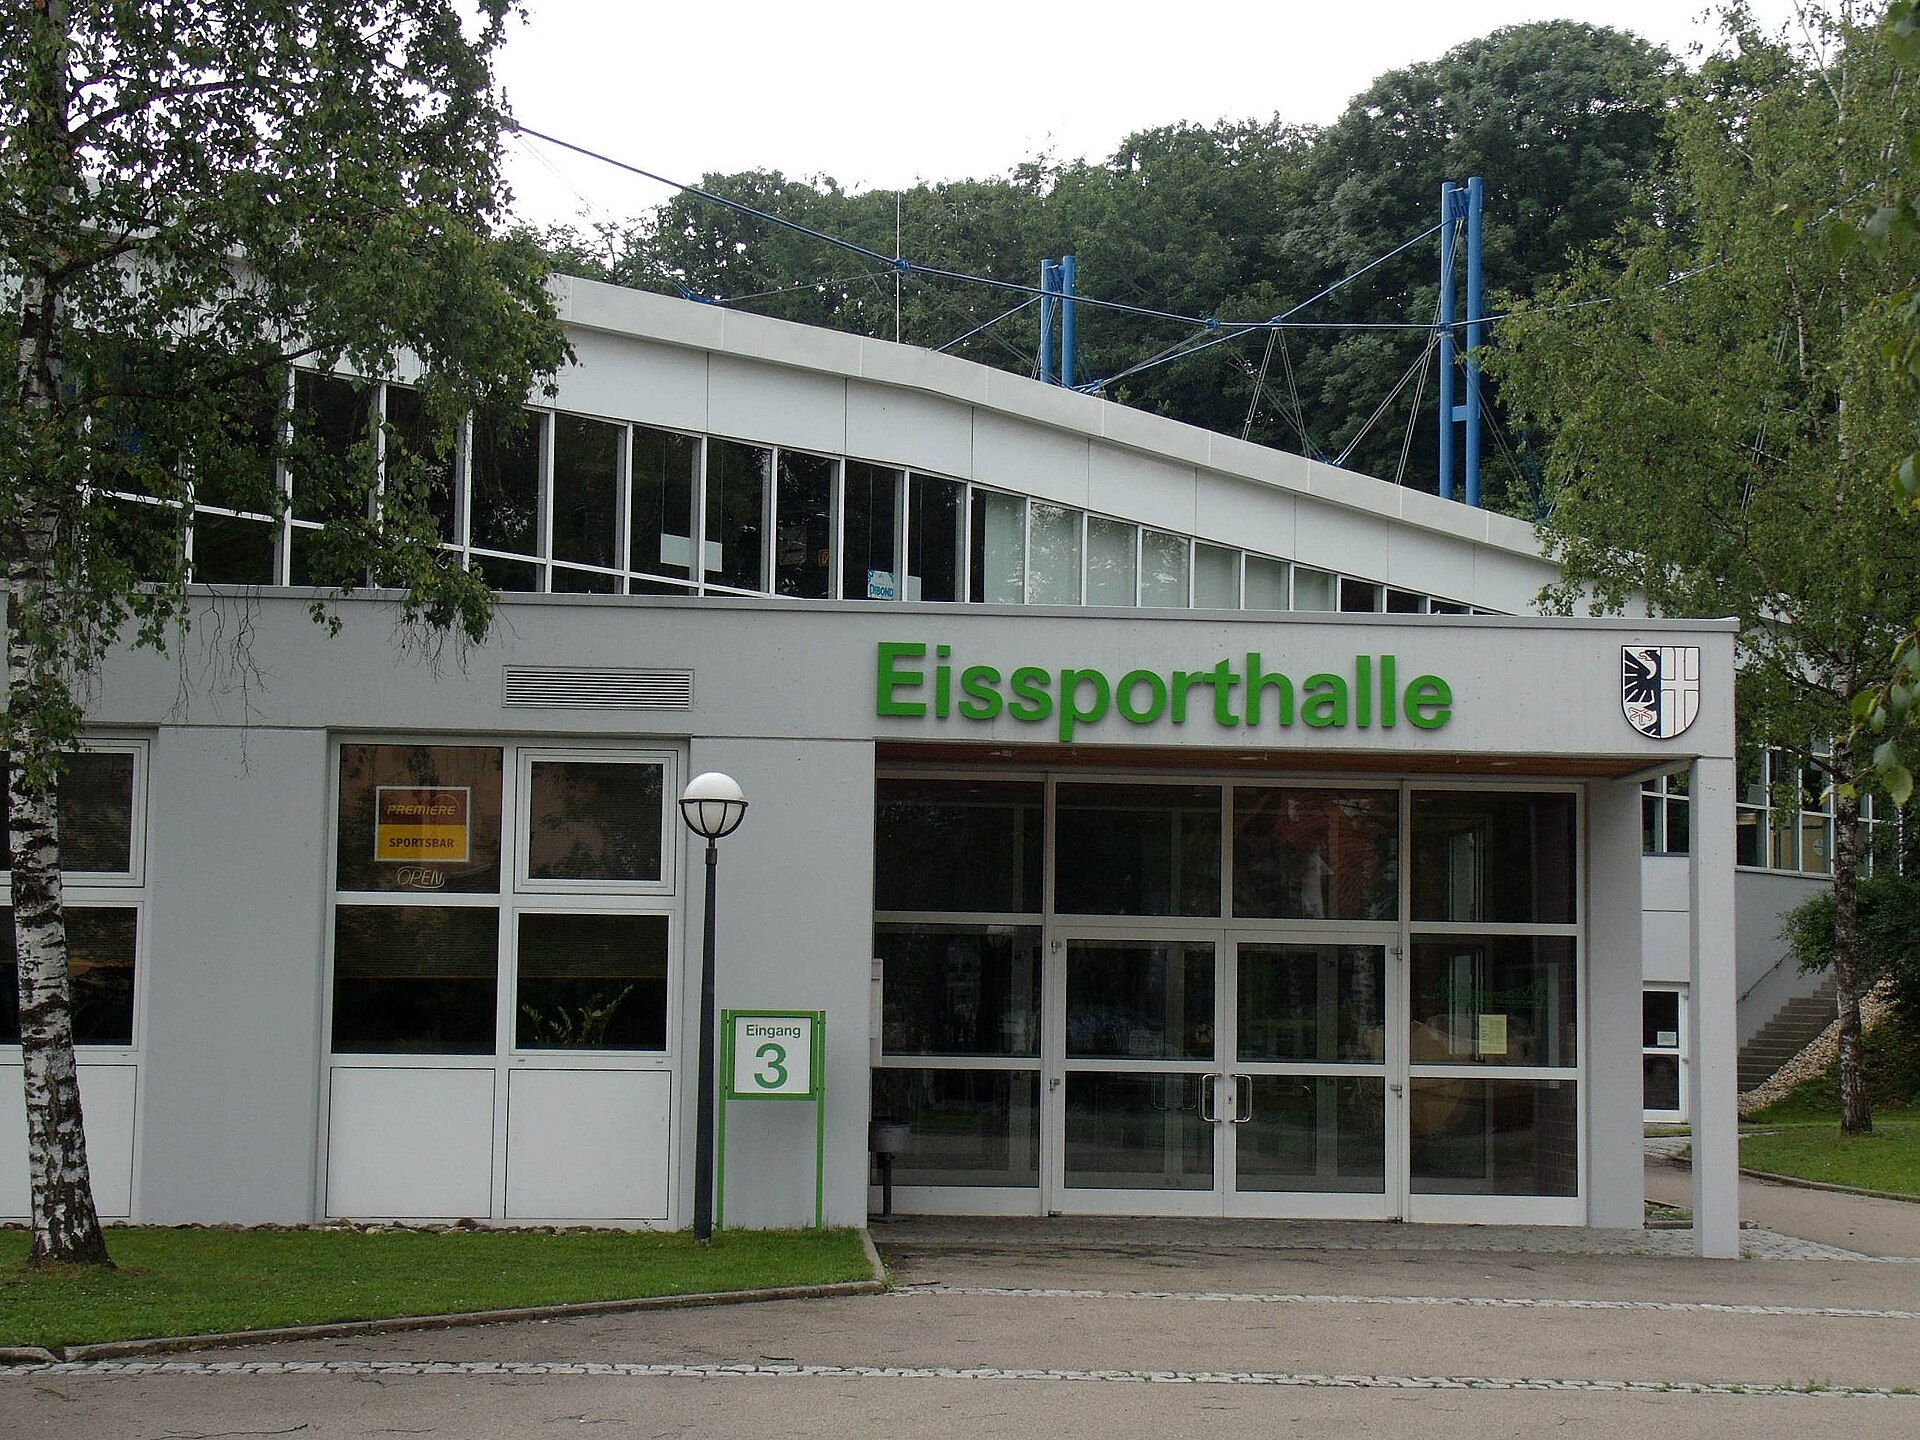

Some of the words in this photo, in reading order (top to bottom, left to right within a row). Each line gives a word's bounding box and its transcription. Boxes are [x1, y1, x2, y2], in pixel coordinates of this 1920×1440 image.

[876, 641, 1453, 742] Eissporthalle
[387, 805, 457, 815] PREMIERE
[389, 838, 454, 848] SPORTSBAR
[397, 868, 443, 886] OPEN
[746, 1024, 801, 1039] Eingang
[754, 1042, 788, 1089] 3
